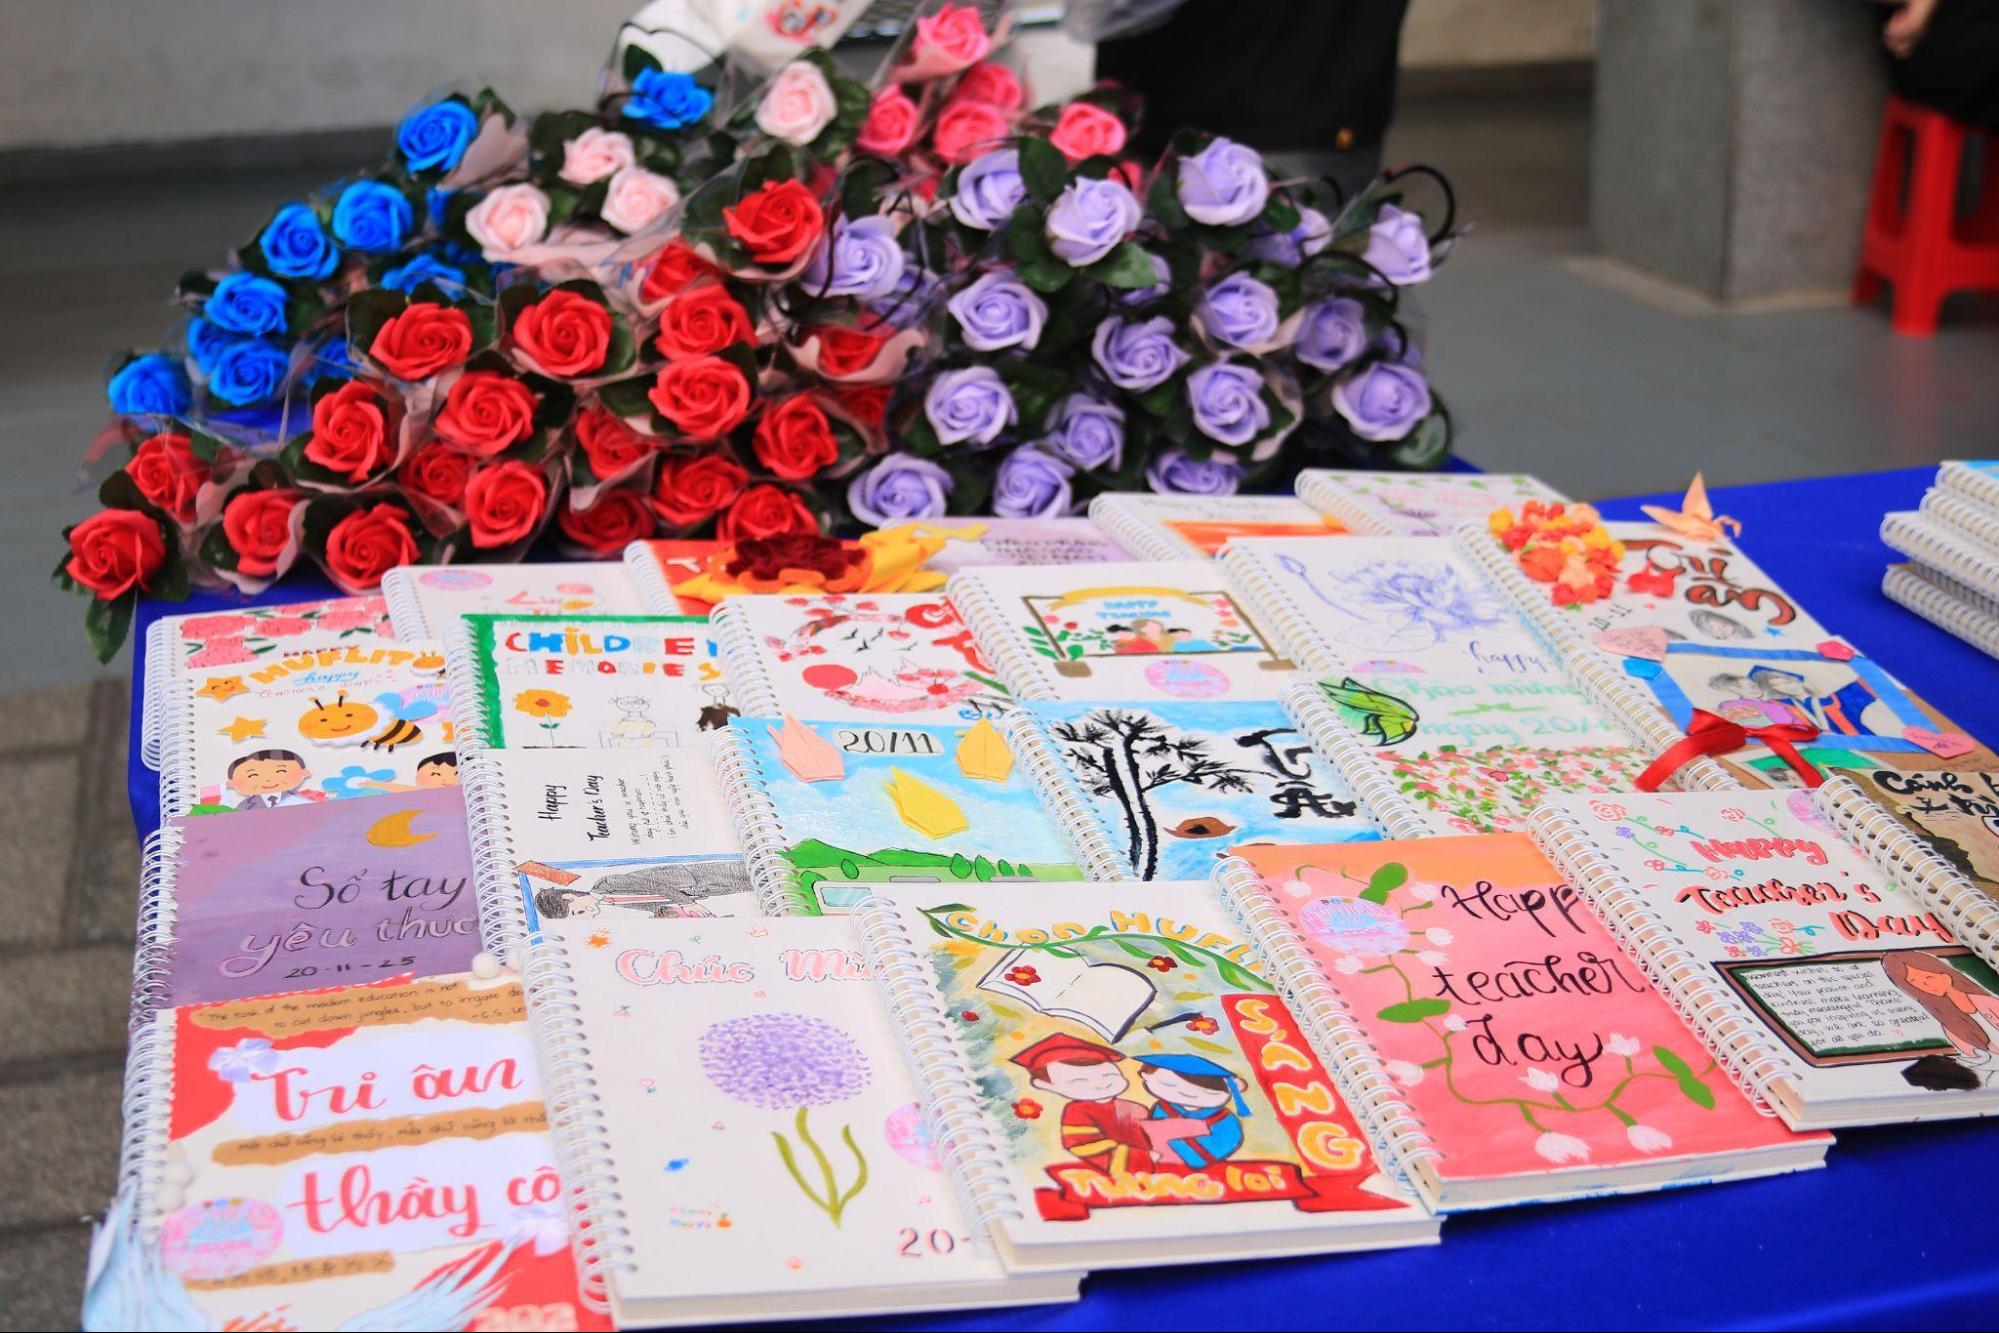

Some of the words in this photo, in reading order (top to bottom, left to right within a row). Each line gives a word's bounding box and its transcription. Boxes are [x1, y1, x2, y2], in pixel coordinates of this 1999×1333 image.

[248, 649, 416, 684] HUFLIT
[839, 729, 935, 754] 20/11
[536, 784, 568, 822] Happy
[582, 774, 605, 796] Day
[585, 798, 611, 843] Teacher's
[1689, 837, 1831, 867] Happy
[294, 865, 368, 910] Sổ
[381, 869, 467, 912] tay
[1440, 880, 1587, 939] Happ
[1673, 870, 1882, 916] Teacher's
[219, 920, 359, 979] yêu
[1098, 909, 1265, 971] HUFL
[1827, 910, 1955, 944] Day
[615, 948, 755, 987] Chúc
[1431, 949, 1646, 1006] teacher
[357, 990, 418, 1002] education
[440, 981, 459, 992] not
[1465, 1013, 1604, 1088] day
[250, 1066, 388, 1122] Tri
[285, 1163, 496, 1239] thầy
[505, 1164, 563, 1207] cô
